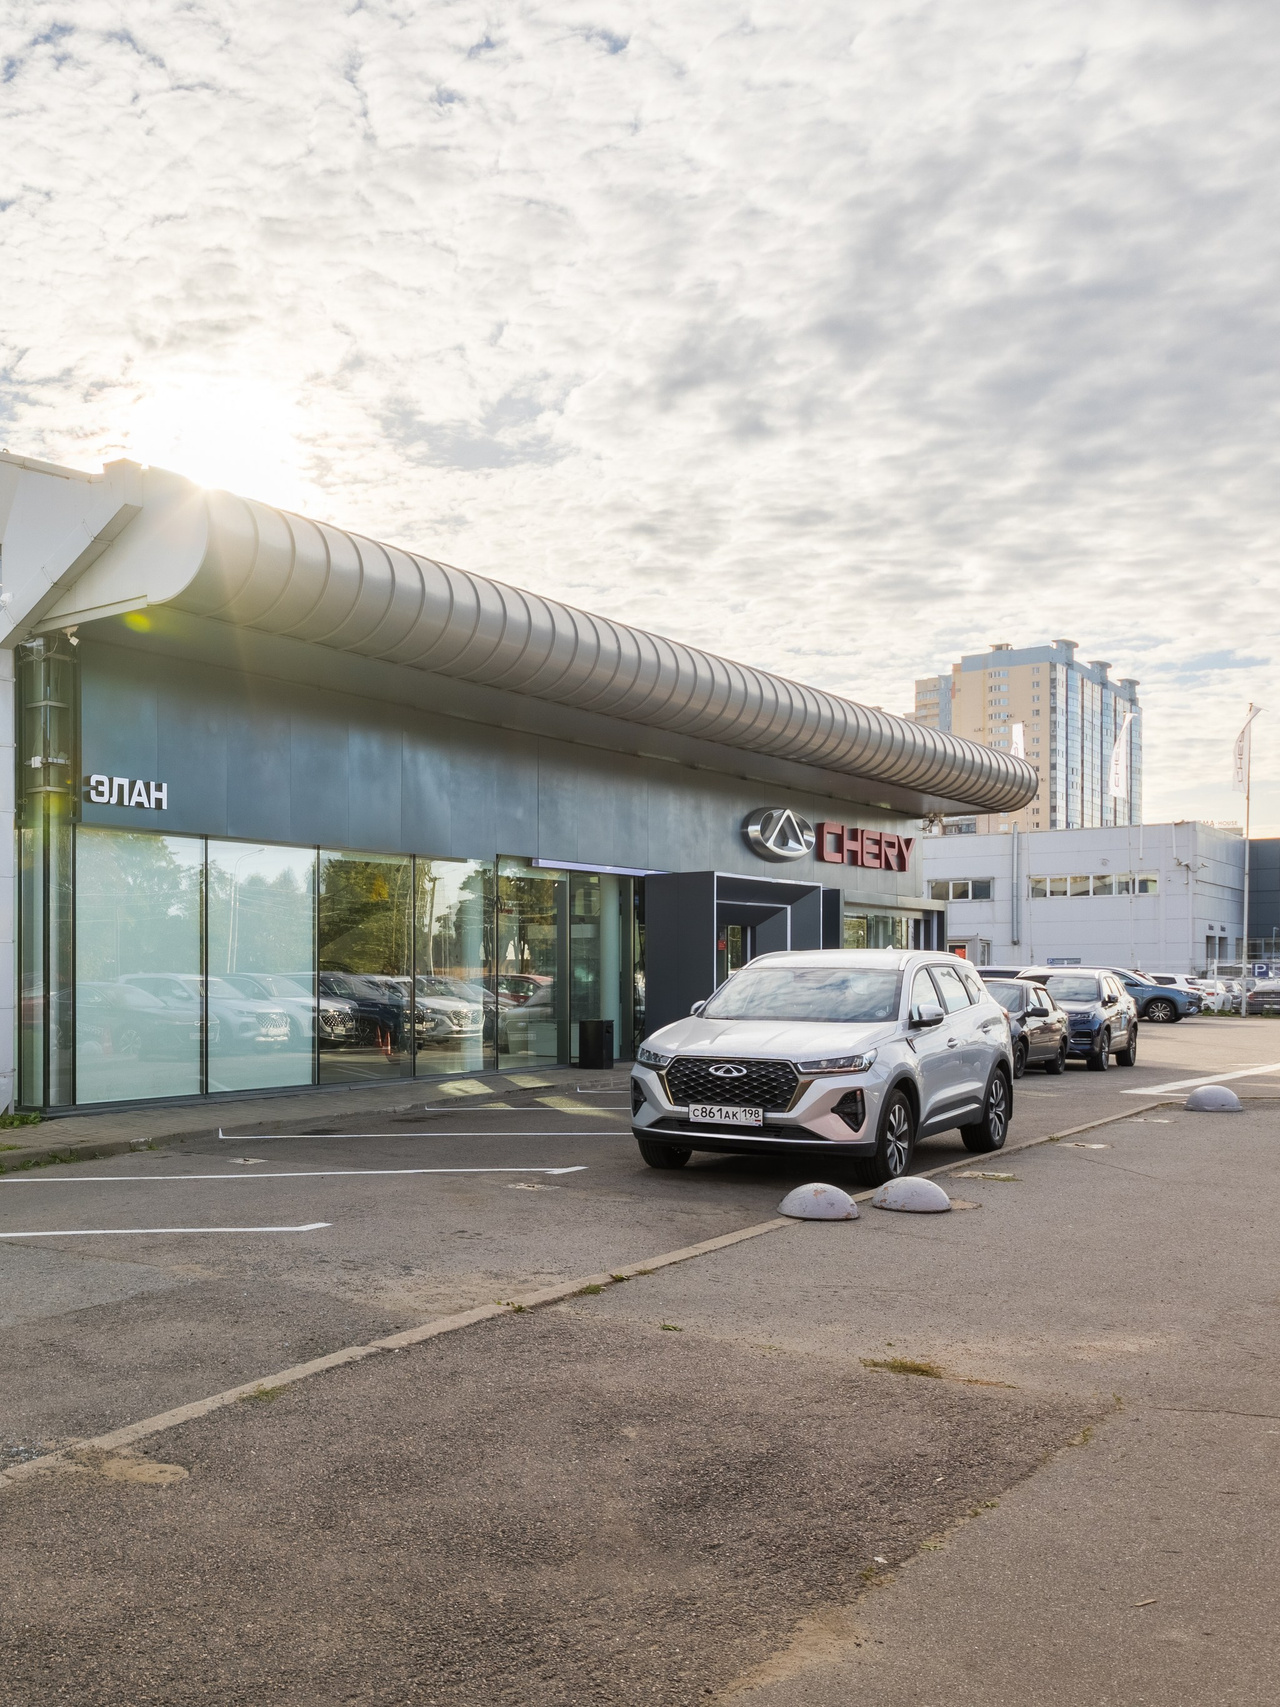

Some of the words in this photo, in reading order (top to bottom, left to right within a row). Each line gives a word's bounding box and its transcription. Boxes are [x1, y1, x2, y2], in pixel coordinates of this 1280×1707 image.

[89, 773, 168, 810] ЭЛАН
[820, 822, 916, 872] CHERY
[1254, 963, 1267, 977] P
[692, 1106, 739, 1121] С861АК
[741, 1108, 760, 1119] 198
